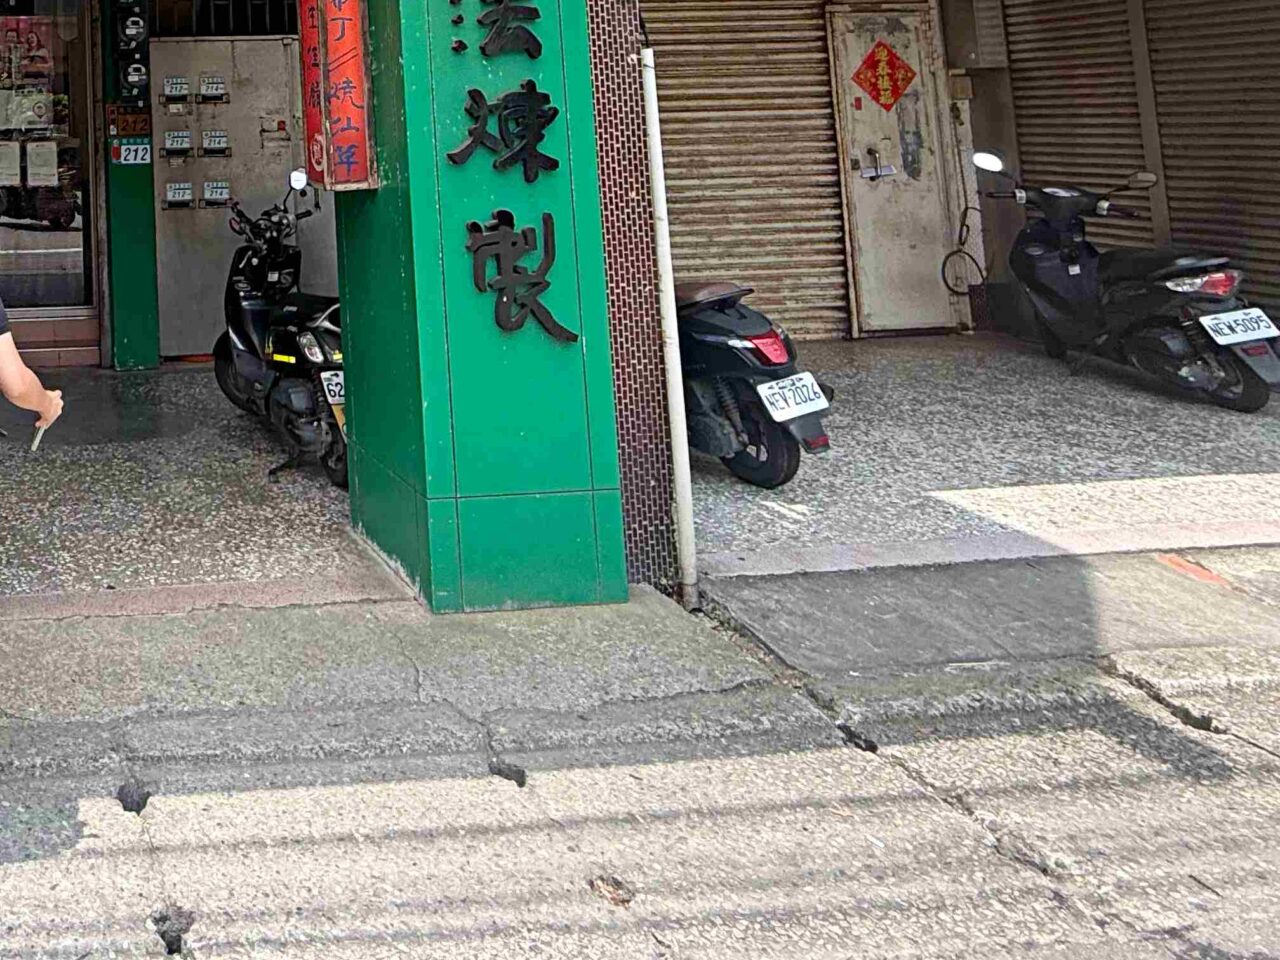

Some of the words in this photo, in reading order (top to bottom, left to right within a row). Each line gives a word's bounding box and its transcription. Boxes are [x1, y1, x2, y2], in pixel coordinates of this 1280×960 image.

[123, 146, 149, 162] 212
[1207, 315, 1271, 338] NEW-5095
[326, 381, 345, 398] 62
[764, 382, 821, 412] NEV-2026
